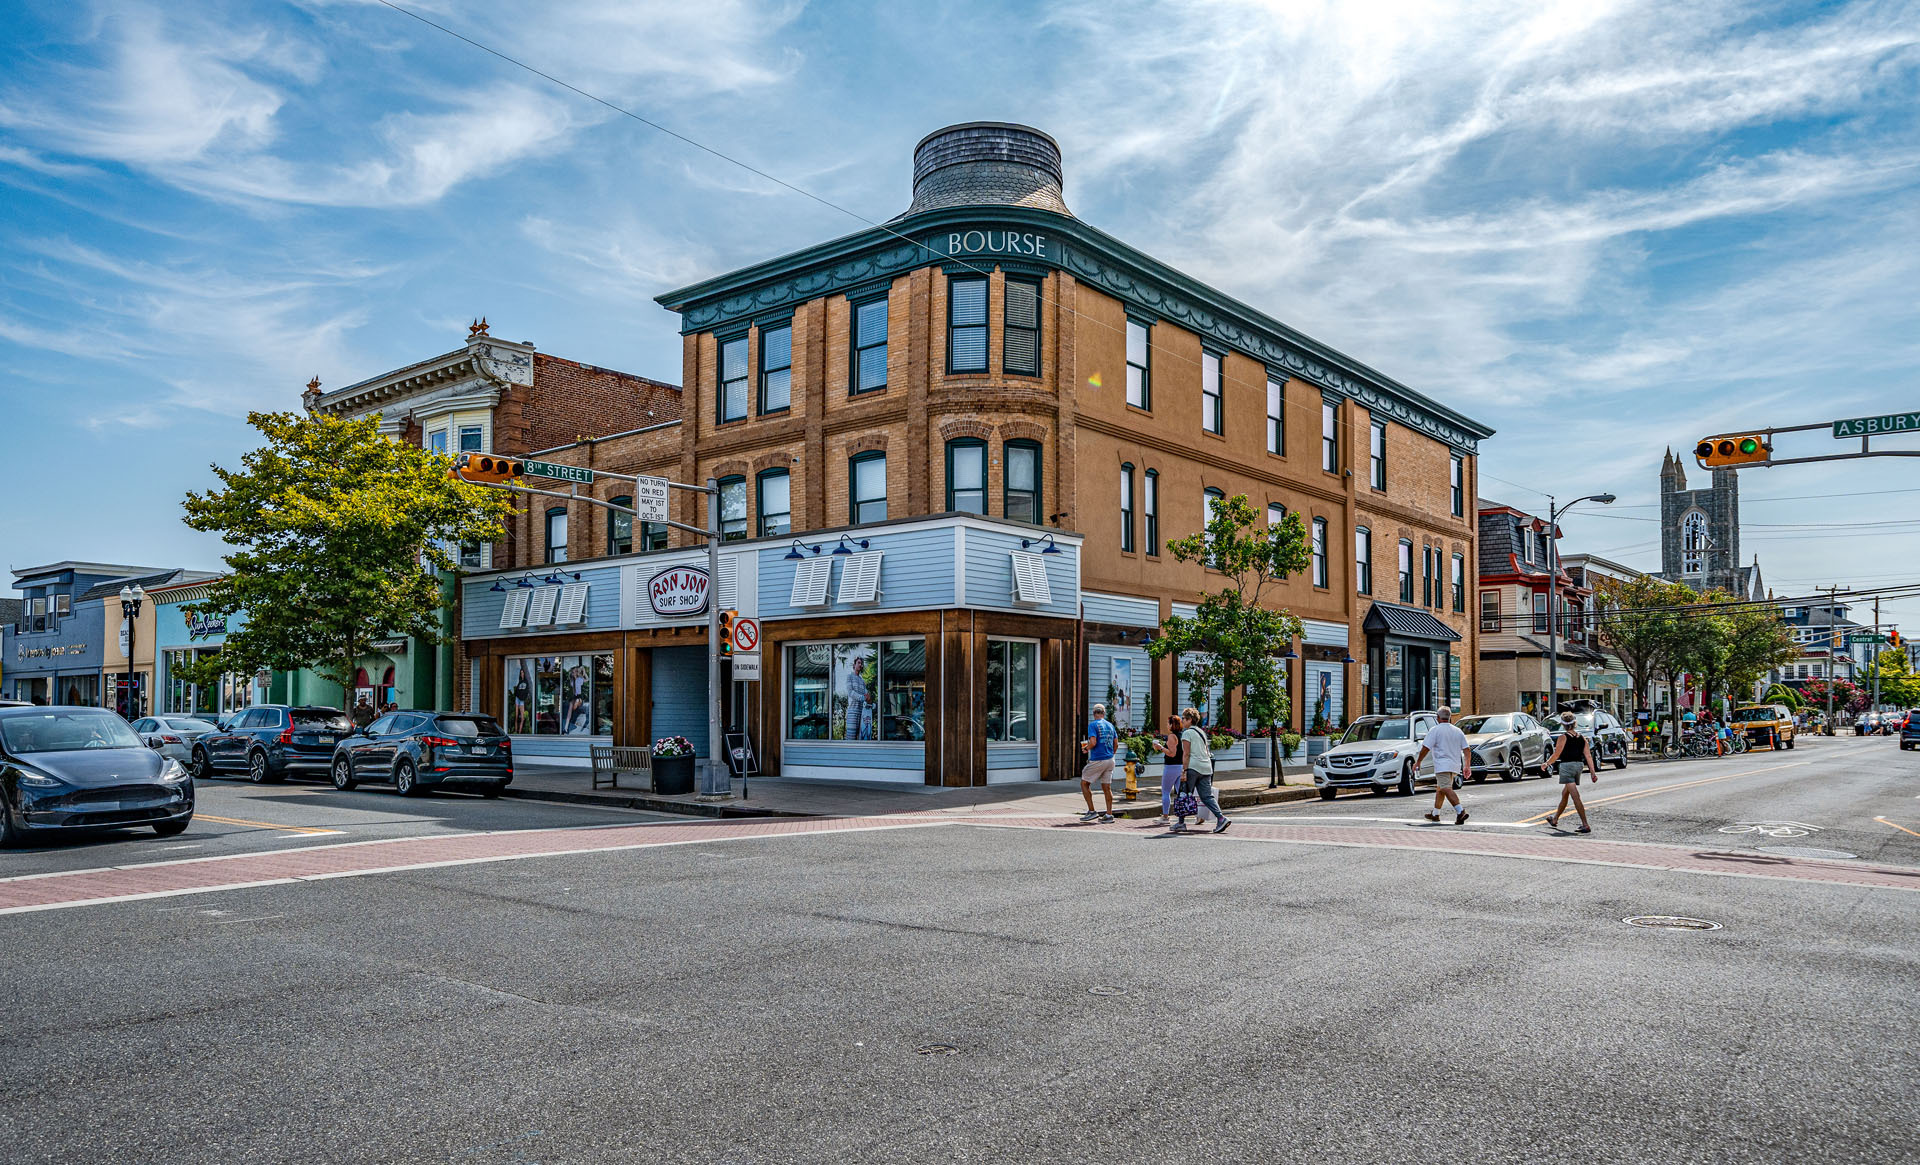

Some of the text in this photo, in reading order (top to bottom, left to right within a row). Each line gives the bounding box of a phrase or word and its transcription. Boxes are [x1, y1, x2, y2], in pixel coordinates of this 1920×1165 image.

[948, 230, 1046, 258] BOURSE
[1838, 414, 1920, 435] ASBURY
[547, 465, 590, 482] STREET
[650, 479, 666, 488] TURN
[641, 487, 664, 496] ON RED
[653, 573, 707, 599] RON JON
[660, 594, 699, 608] SURF SHOP
[740, 663, 758, 671] SIDEWALK
